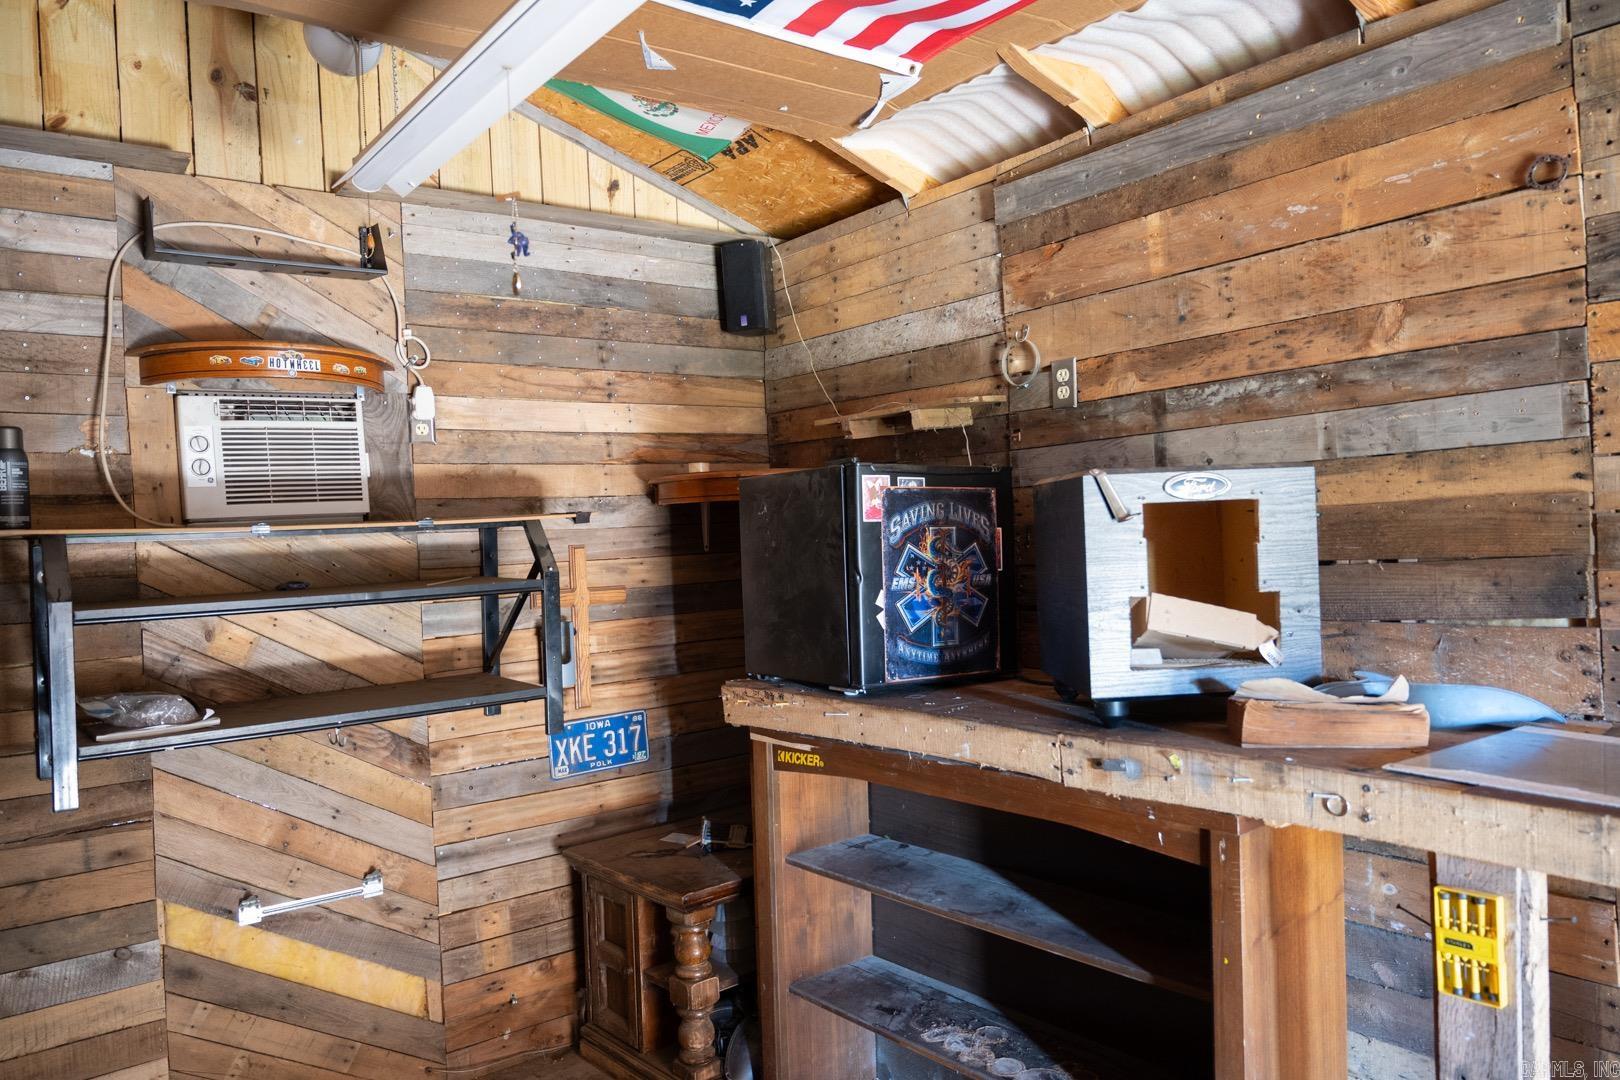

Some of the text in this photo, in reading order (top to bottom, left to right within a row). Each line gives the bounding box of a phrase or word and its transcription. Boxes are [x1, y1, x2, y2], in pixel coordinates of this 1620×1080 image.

[720, 133, 759, 160] APA
[890, 502, 992, 544] SAVING LIVES
[891, 576, 916, 590] EMS
[586, 720, 611, 731] IOWA
[555, 724, 641, 768] XKE 317
[590, 759, 613, 768] POLK
[785, 751, 821, 767] KICKER
